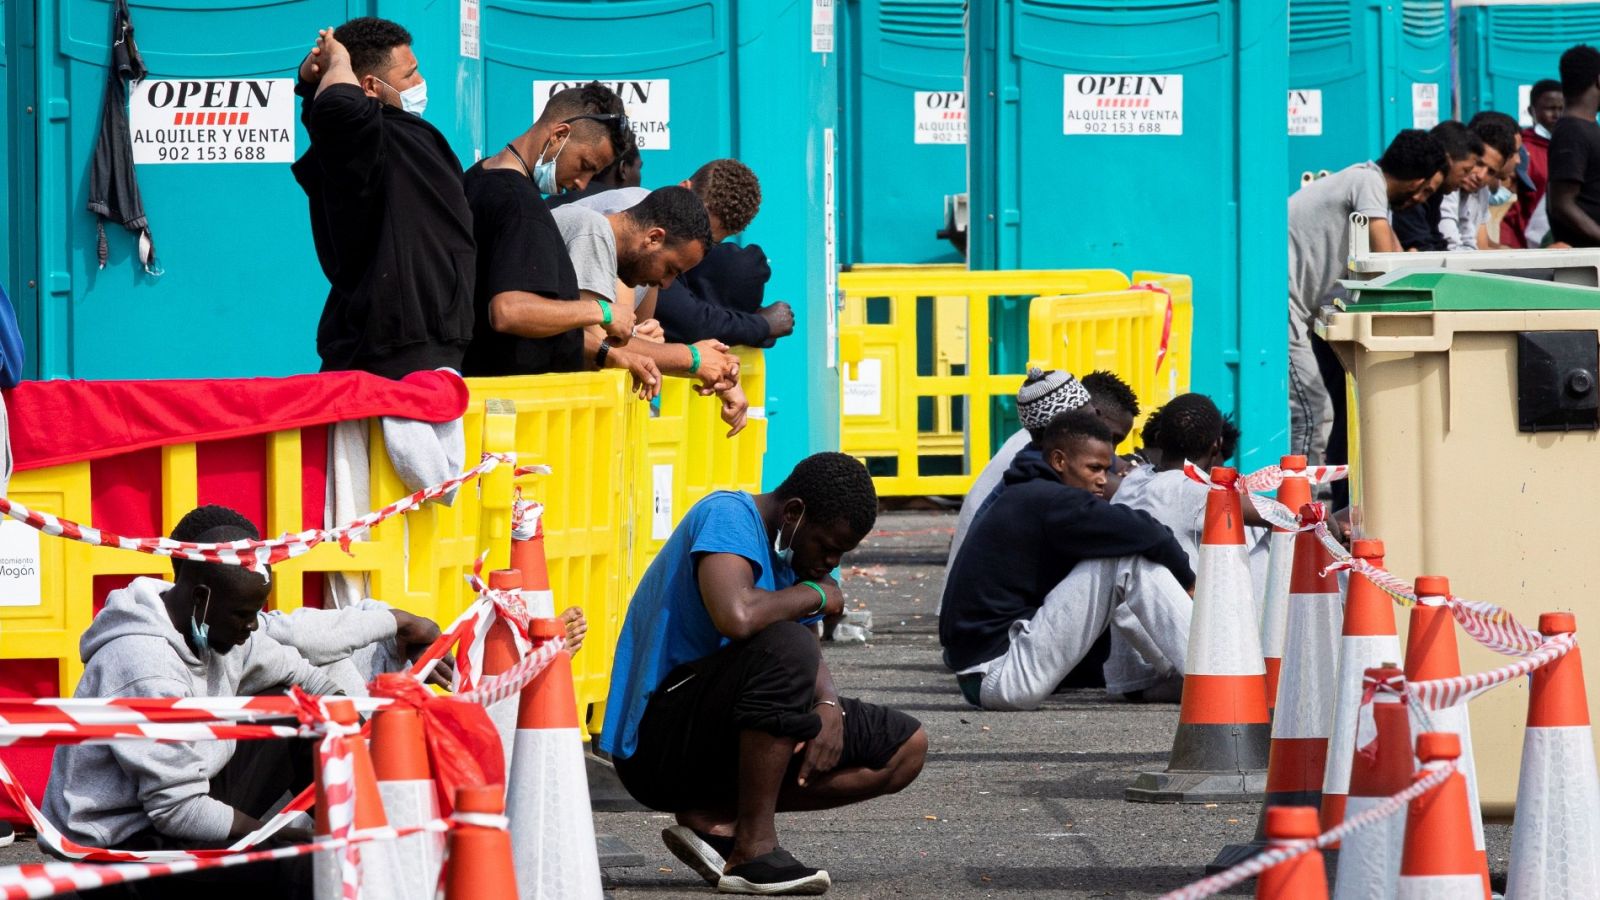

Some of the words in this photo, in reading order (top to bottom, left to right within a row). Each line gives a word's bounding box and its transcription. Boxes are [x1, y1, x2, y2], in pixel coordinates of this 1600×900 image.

[1077, 75, 1167, 95] OPEIN
[147, 80, 275, 109] OPEIN
[1067, 109, 1127, 121] ALQUILER
[1130, 109, 1138, 120] Y
[1141, 109, 1180, 120] VENTA
[631, 120, 666, 133] ENTA
[1084, 122, 1108, 133] 902
[1112, 122, 1134, 133] 153
[1138, 122, 1162, 133] 688
[133, 128, 218, 145] ALQUILER
[222, 128, 233, 143] Y
[237, 128, 290, 143] VENTA
[158, 146, 190, 161] 902
[197, 146, 228, 161] 153
[234, 146, 266, 161] 688
